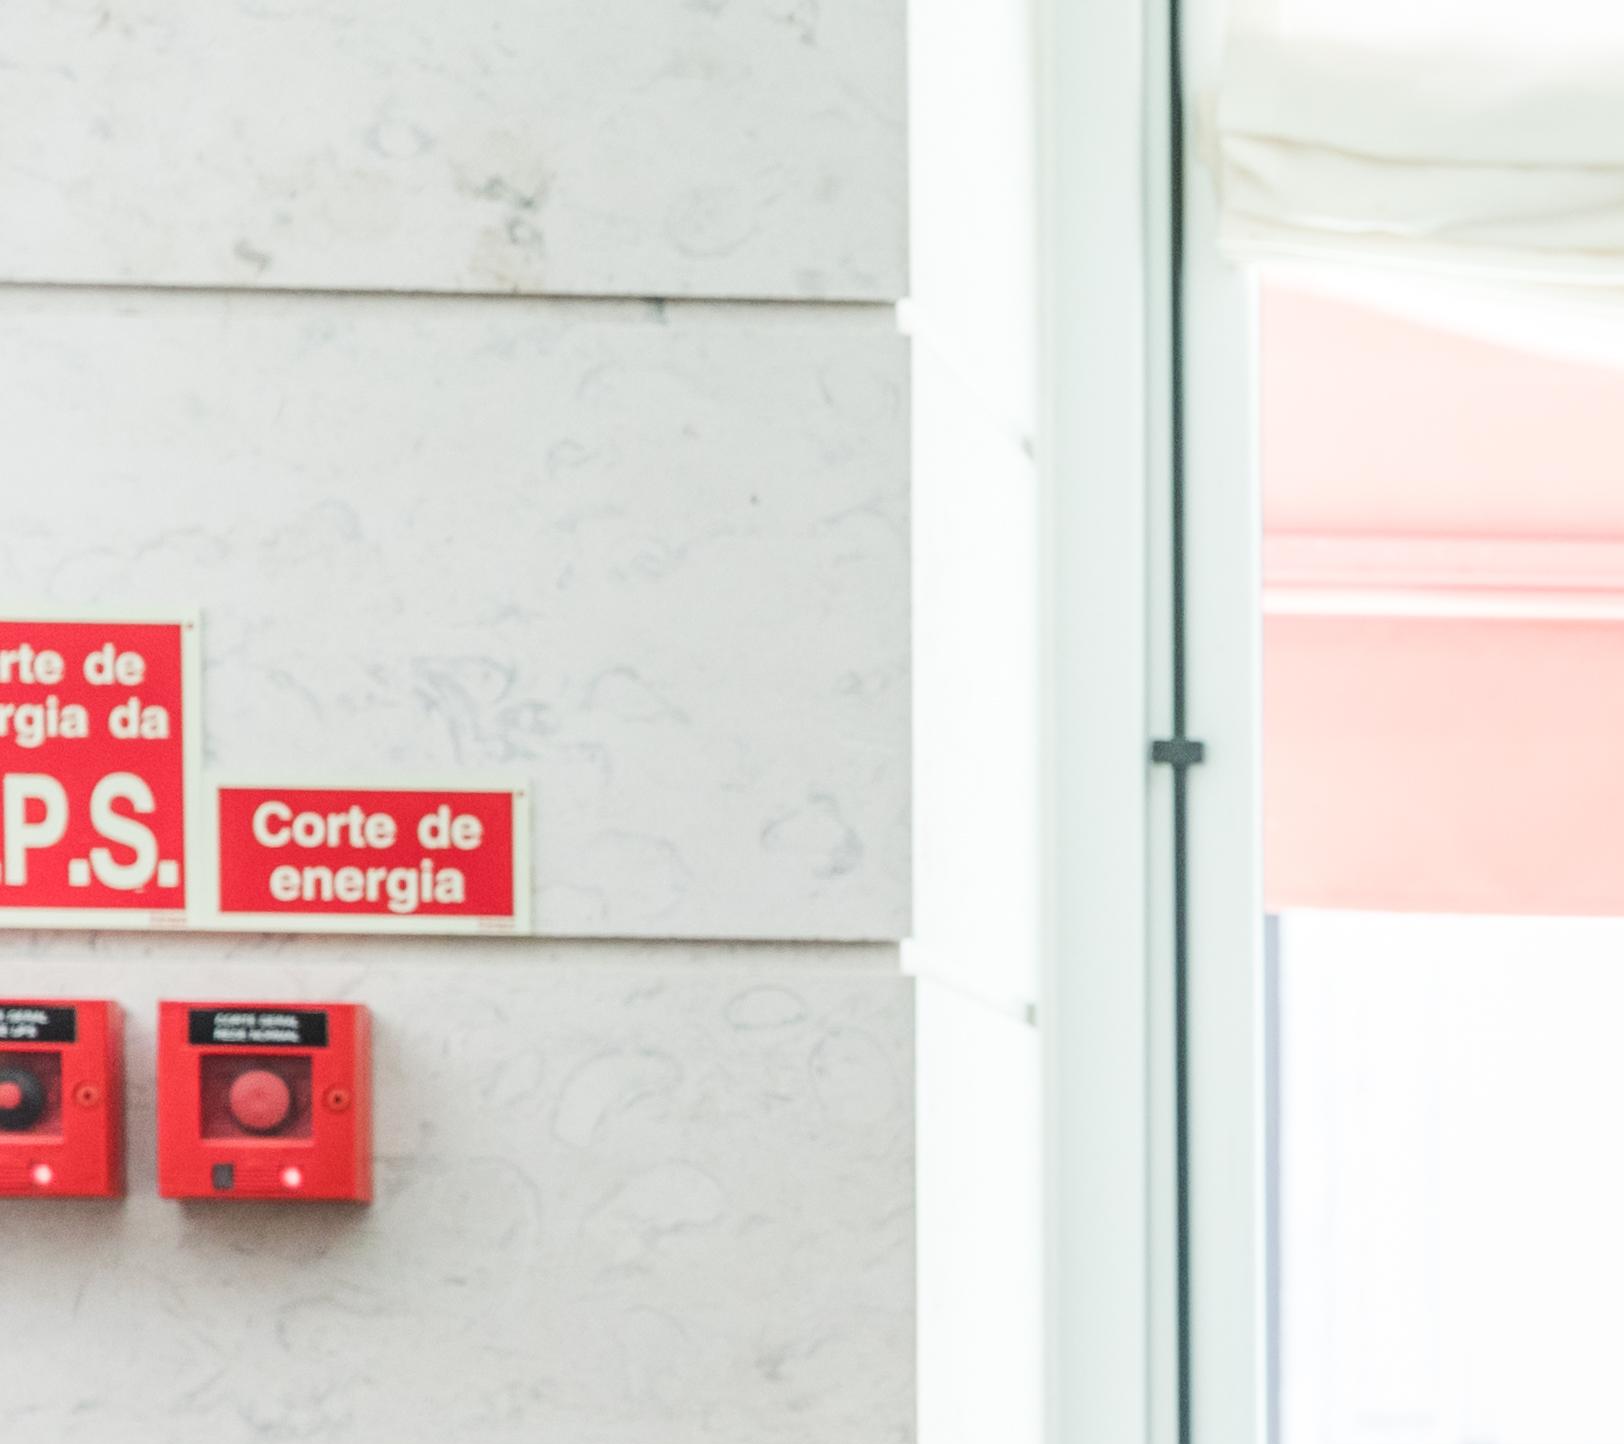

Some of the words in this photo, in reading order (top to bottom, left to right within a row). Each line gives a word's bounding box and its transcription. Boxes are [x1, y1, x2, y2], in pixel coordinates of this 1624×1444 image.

[0, 643, 64, 685] rte
[83, 642, 146, 686] de
[108, 696, 169, 740] da
[252, 799, 397, 849] Corte
[417, 804, 483, 850] de
[268, 857, 465, 914] energia
